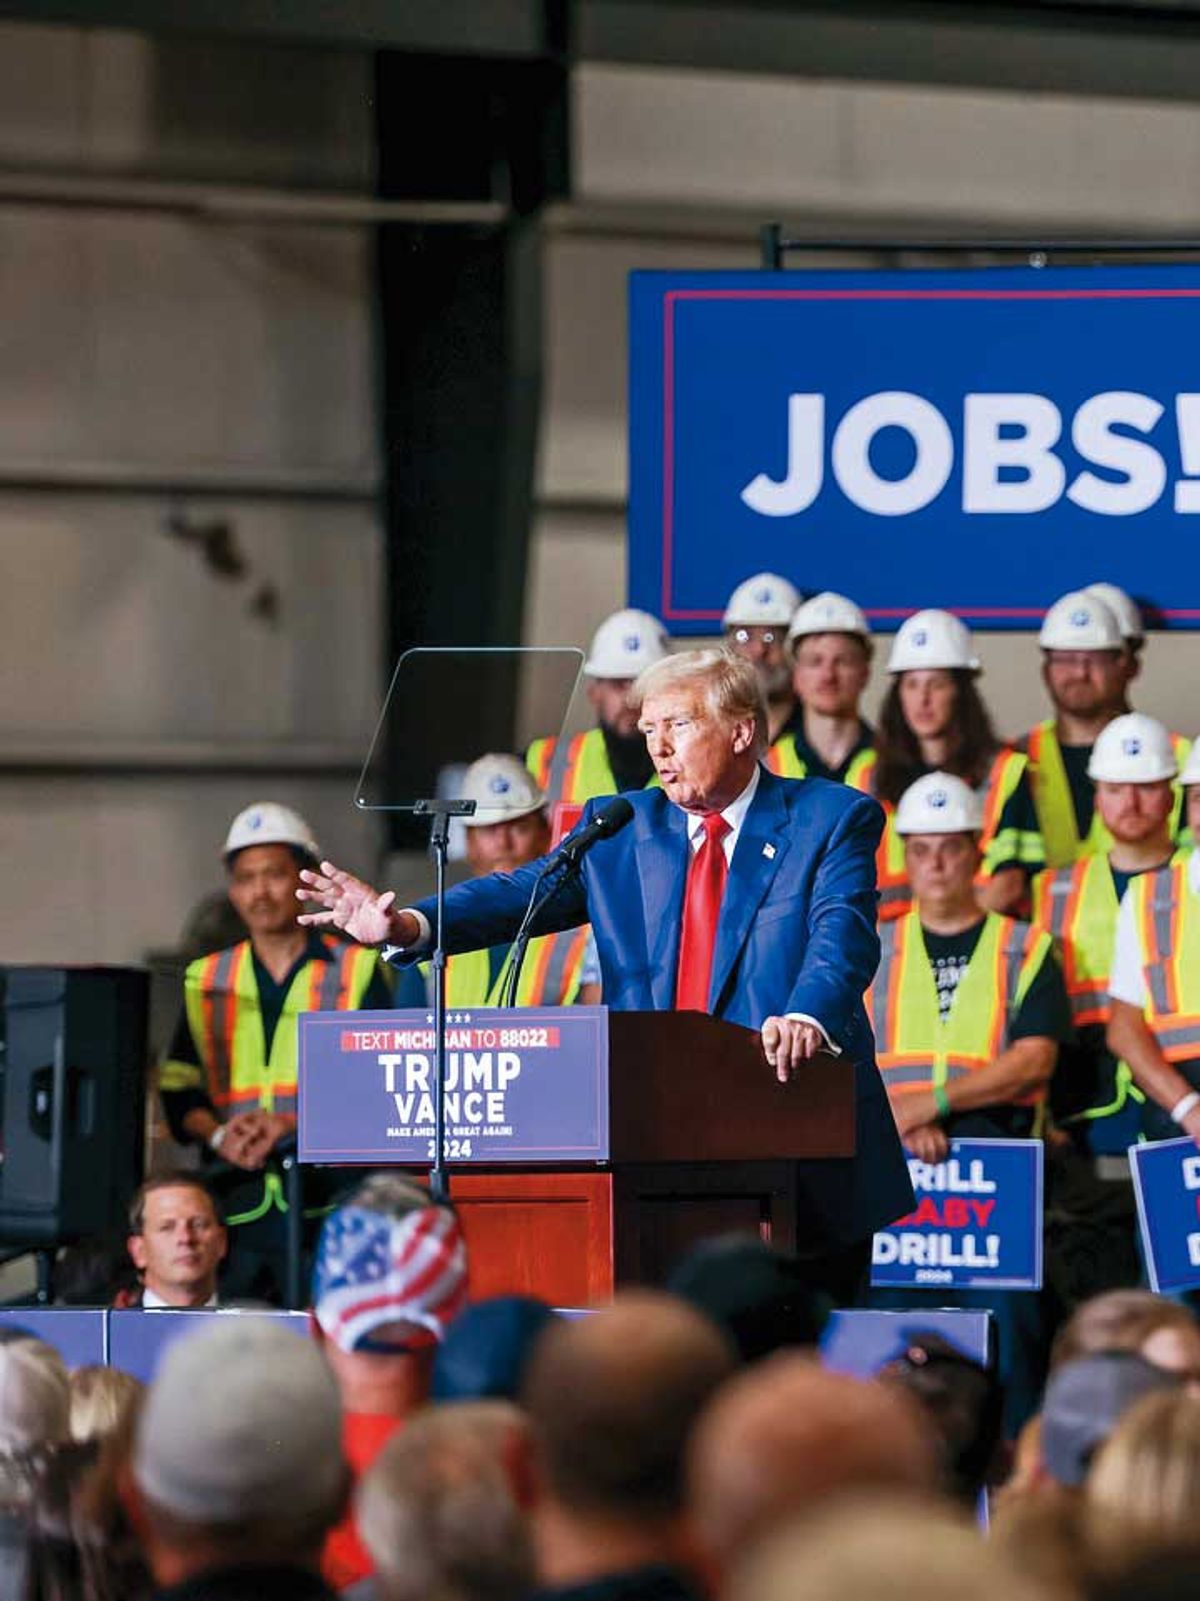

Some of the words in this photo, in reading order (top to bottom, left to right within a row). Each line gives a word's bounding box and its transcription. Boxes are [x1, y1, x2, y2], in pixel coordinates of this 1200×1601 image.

[353, 1031, 390, 1050] TEXT
[394, 1030, 471, 1050] MICHIAN
[475, 1029, 497, 1047] TO
[500, 1028, 549, 1048] 88022
[394, 1092, 506, 1124] VANCE
[906, 1159, 997, 1194] RILL
[888, 1195, 996, 1229] ABY
[871, 1231, 1000, 1268] DRILL!
